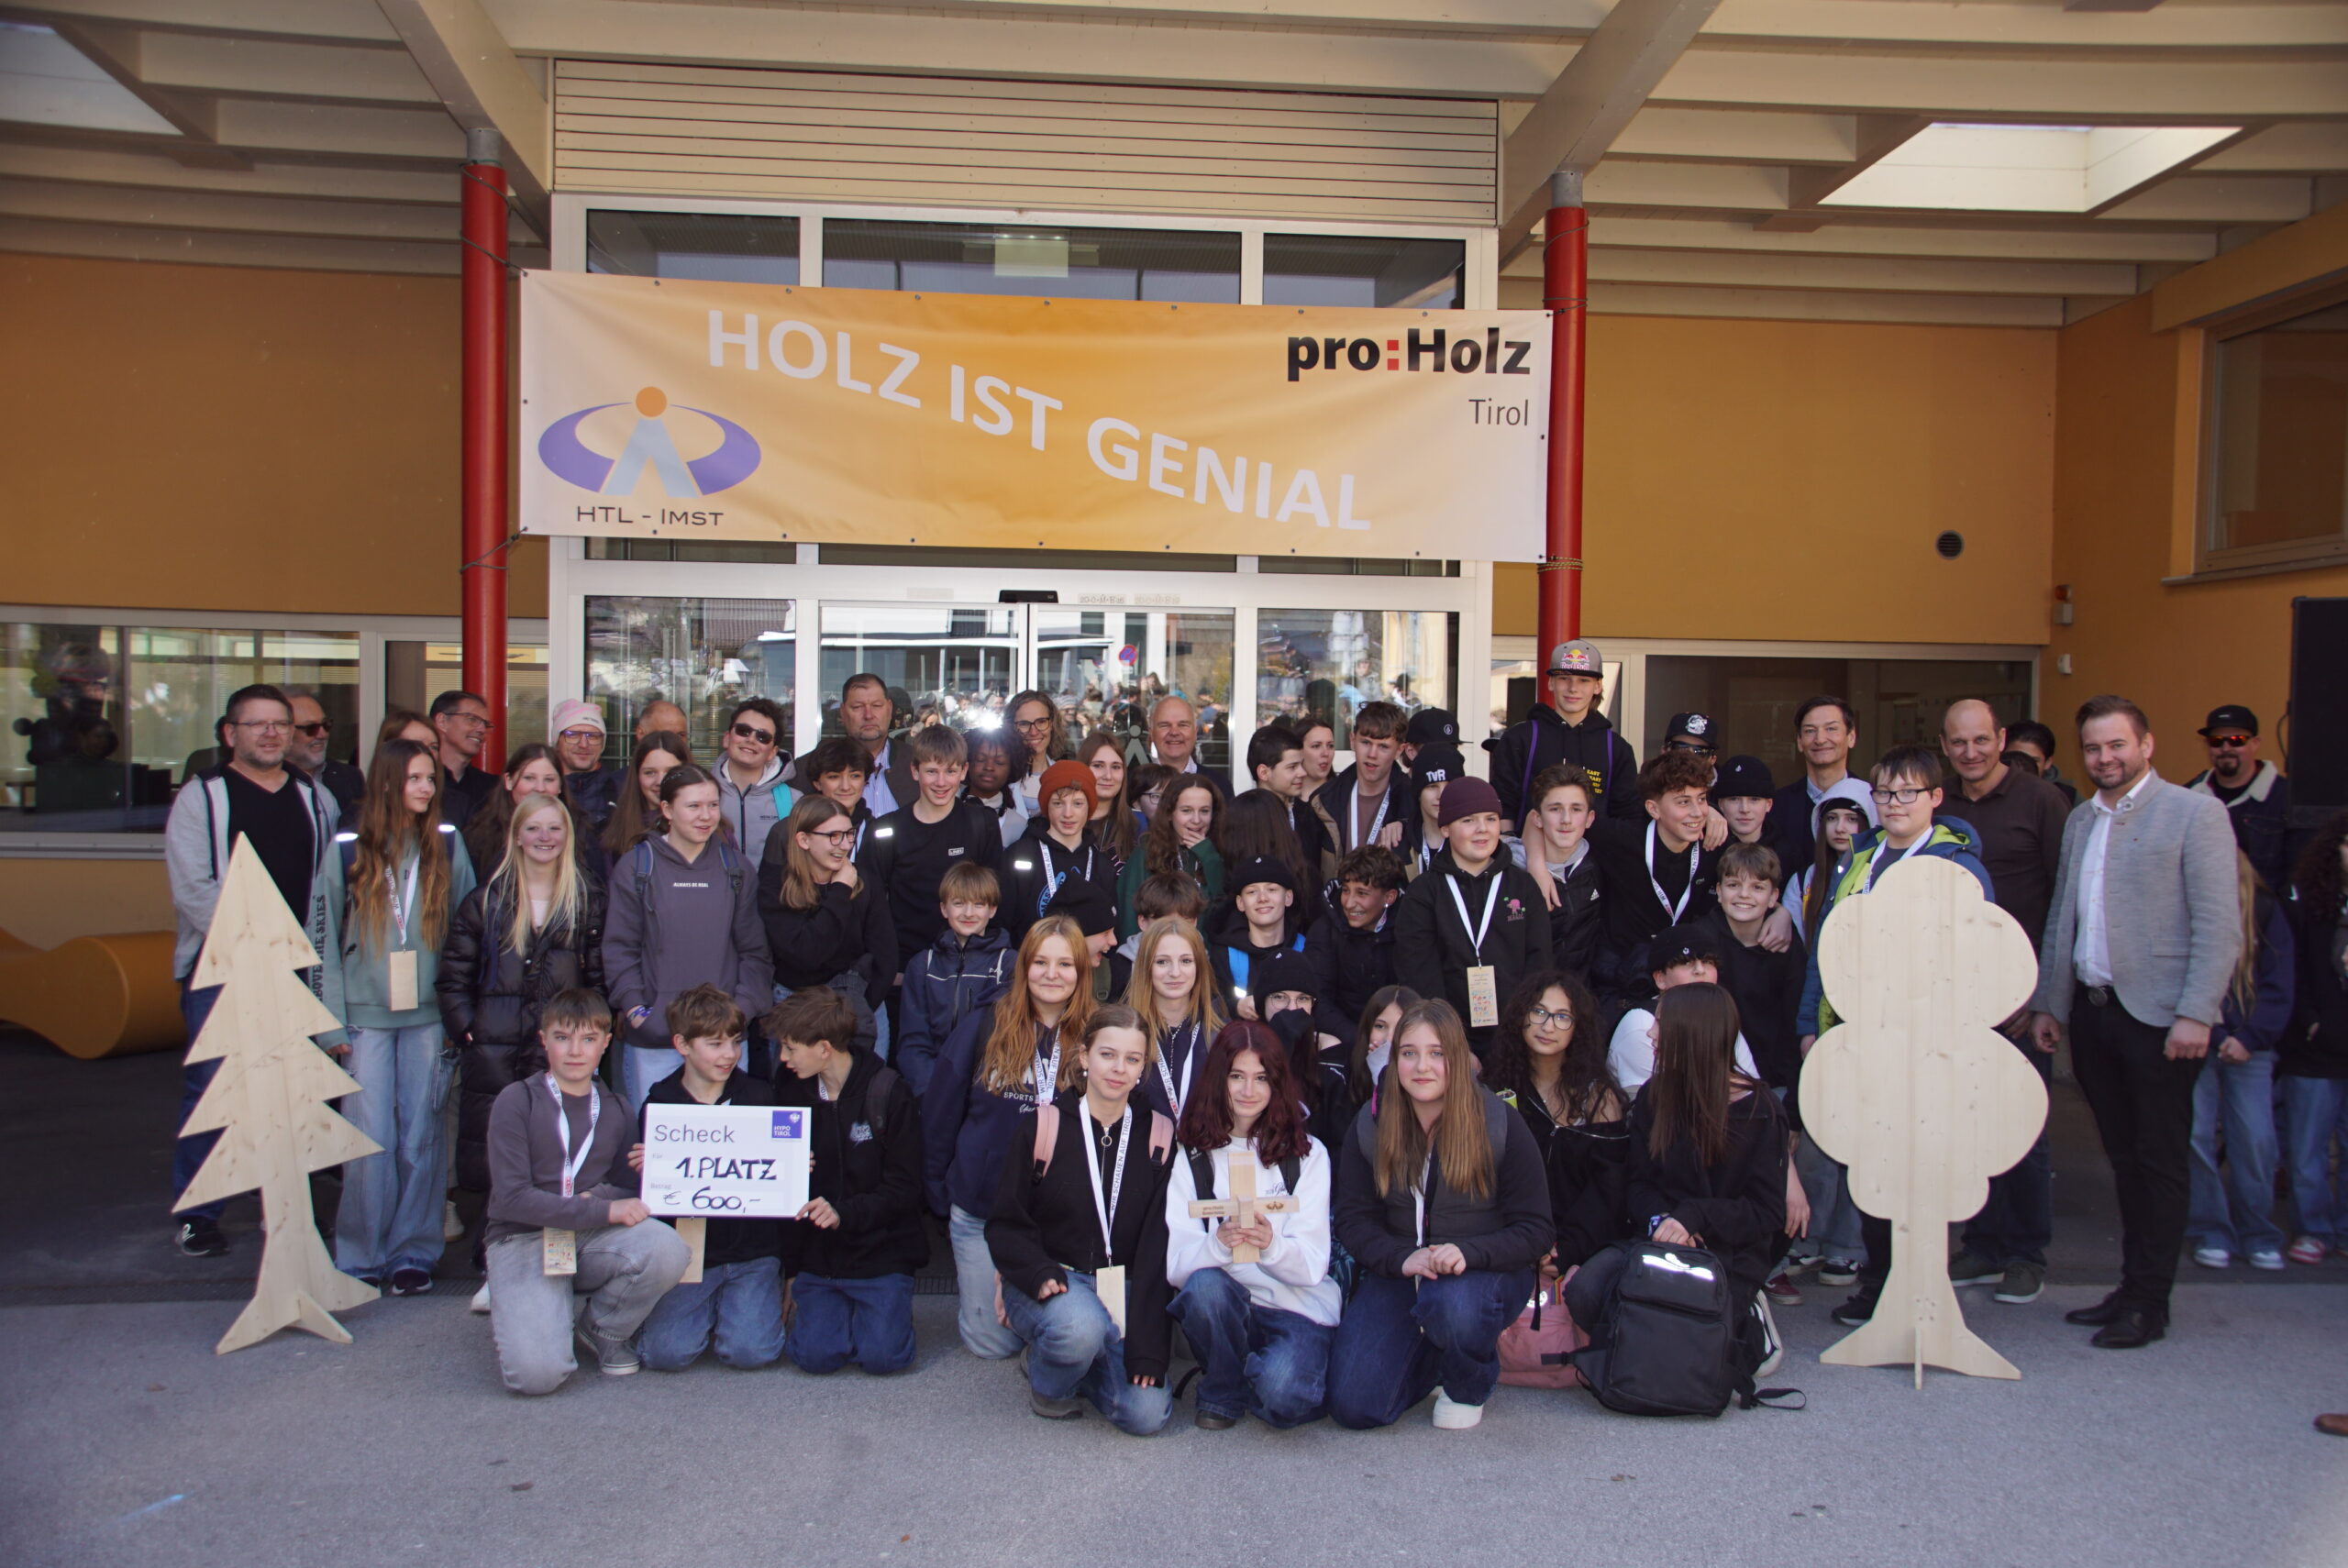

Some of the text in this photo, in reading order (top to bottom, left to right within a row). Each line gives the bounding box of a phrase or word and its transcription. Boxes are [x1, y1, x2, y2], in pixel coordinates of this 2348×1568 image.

[1287, 326, 1532, 382] pro:Holz
[708, 309, 1371, 531] HOLZ IST GENIAL
[1468, 398, 1530, 426] Tirol
[576, 505, 634, 524] HTL
[660, 508, 724, 526] IMST
[313, 966, 323, 1001] BOVE
[1003, 1091, 1034, 1102] SPORTS
[654, 1123, 736, 1143] Scheck
[1118, 1139, 1127, 1154] AUF
[1113, 1156, 1124, 1194] SCHAUEN
